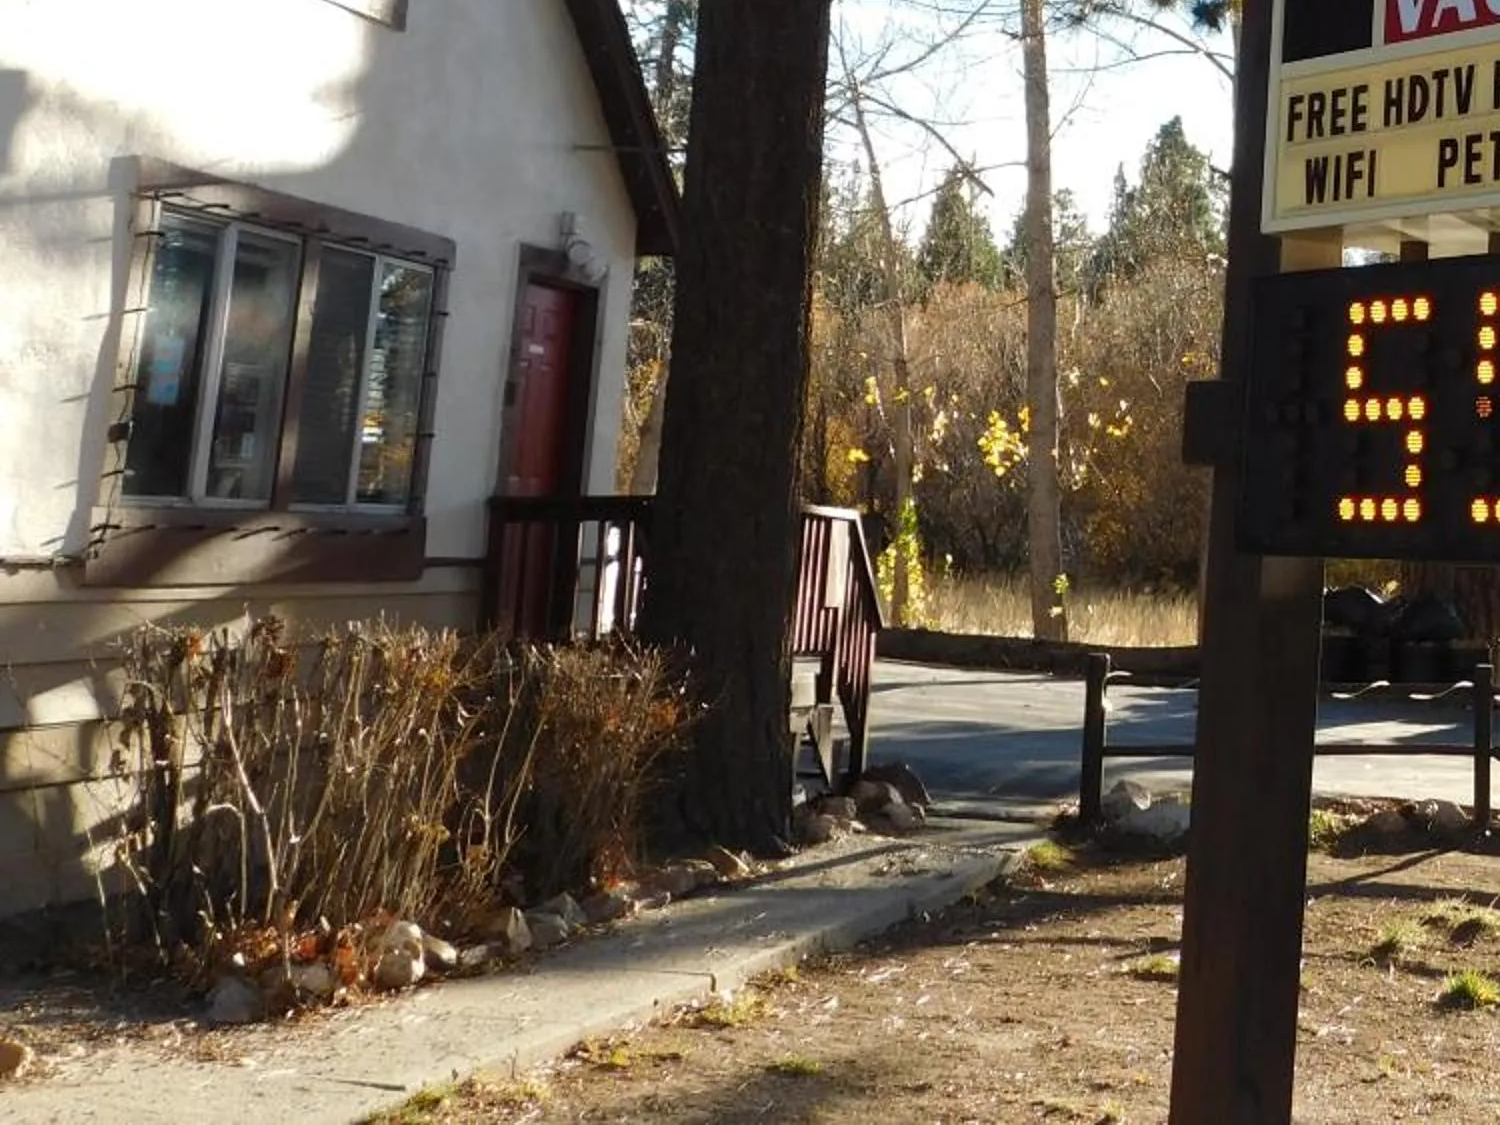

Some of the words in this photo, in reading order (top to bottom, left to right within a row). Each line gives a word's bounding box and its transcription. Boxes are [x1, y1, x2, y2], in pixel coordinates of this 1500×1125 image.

[1287, 83, 1368, 143] FREE
[1383, 64, 1475, 127] HDTV
[1305, 149, 1377, 206] WIFI
